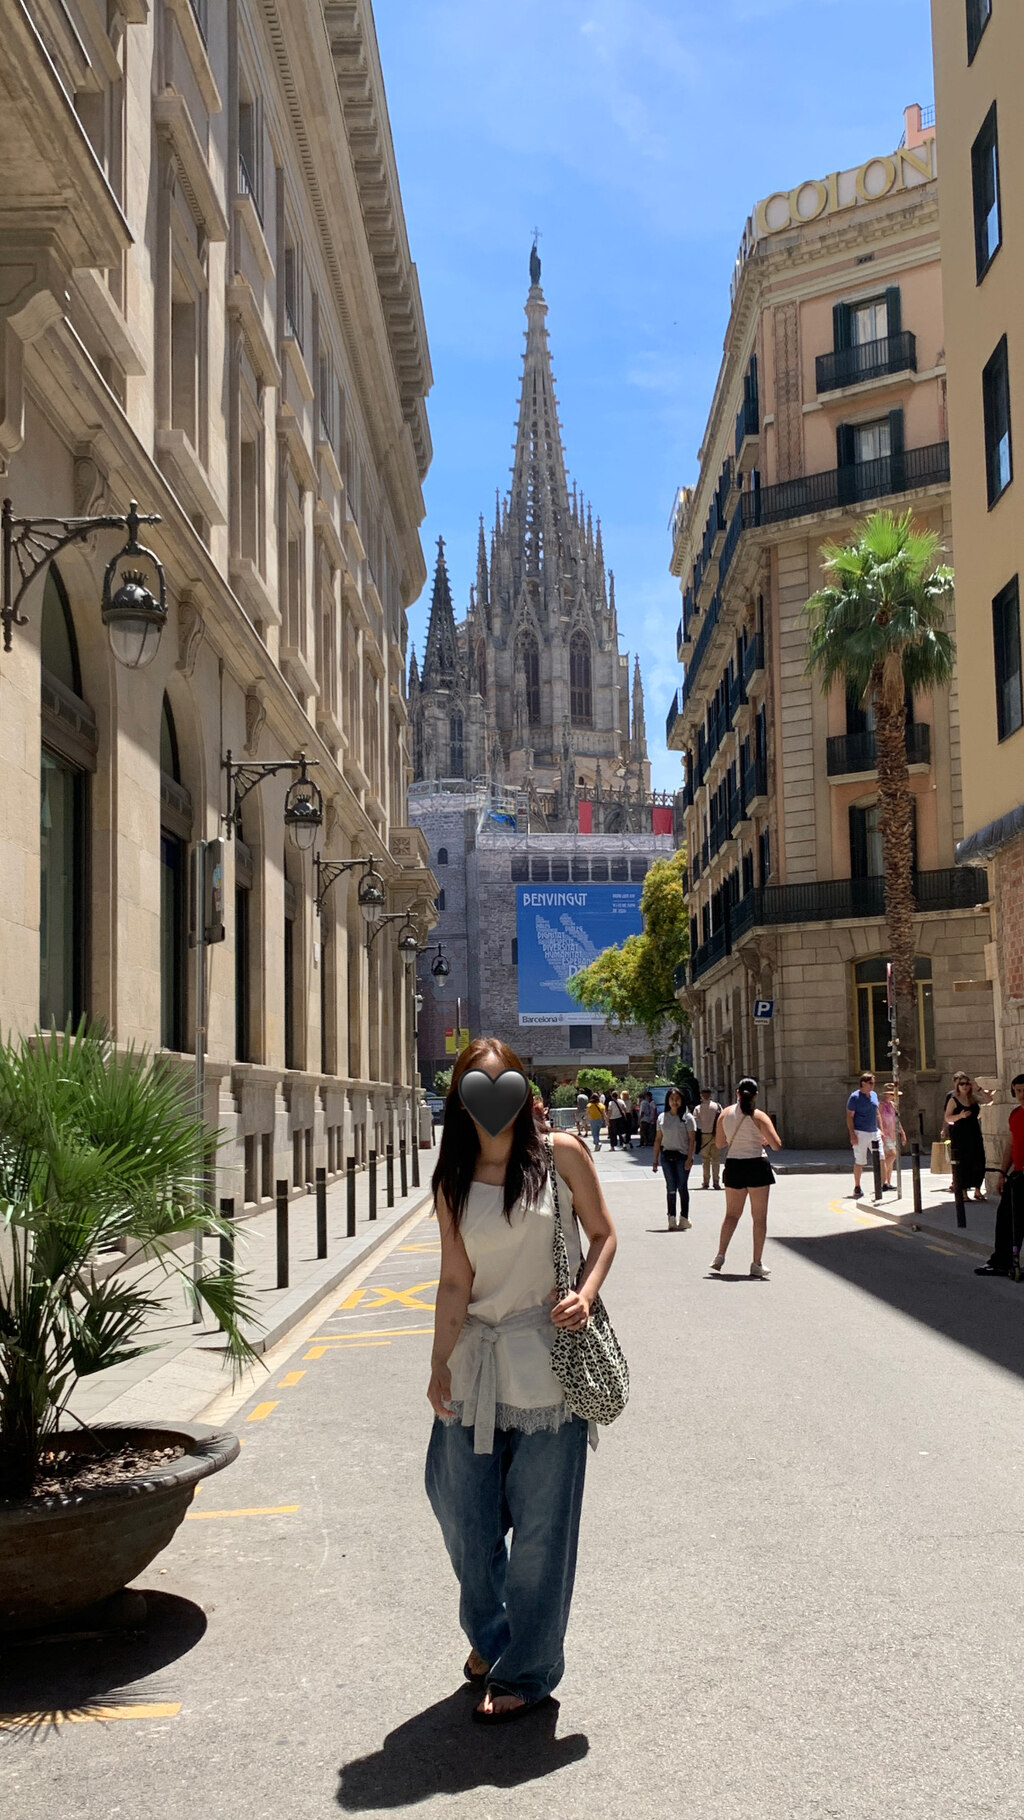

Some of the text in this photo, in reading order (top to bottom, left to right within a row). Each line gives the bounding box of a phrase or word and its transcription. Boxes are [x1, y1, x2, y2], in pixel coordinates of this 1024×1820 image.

[758, 137, 935, 234] COLON
[523, 893, 588, 907] BENVINGUT
[757, 1001, 771, 1016] P
[522, 1015, 558, 1023] Barcelona
